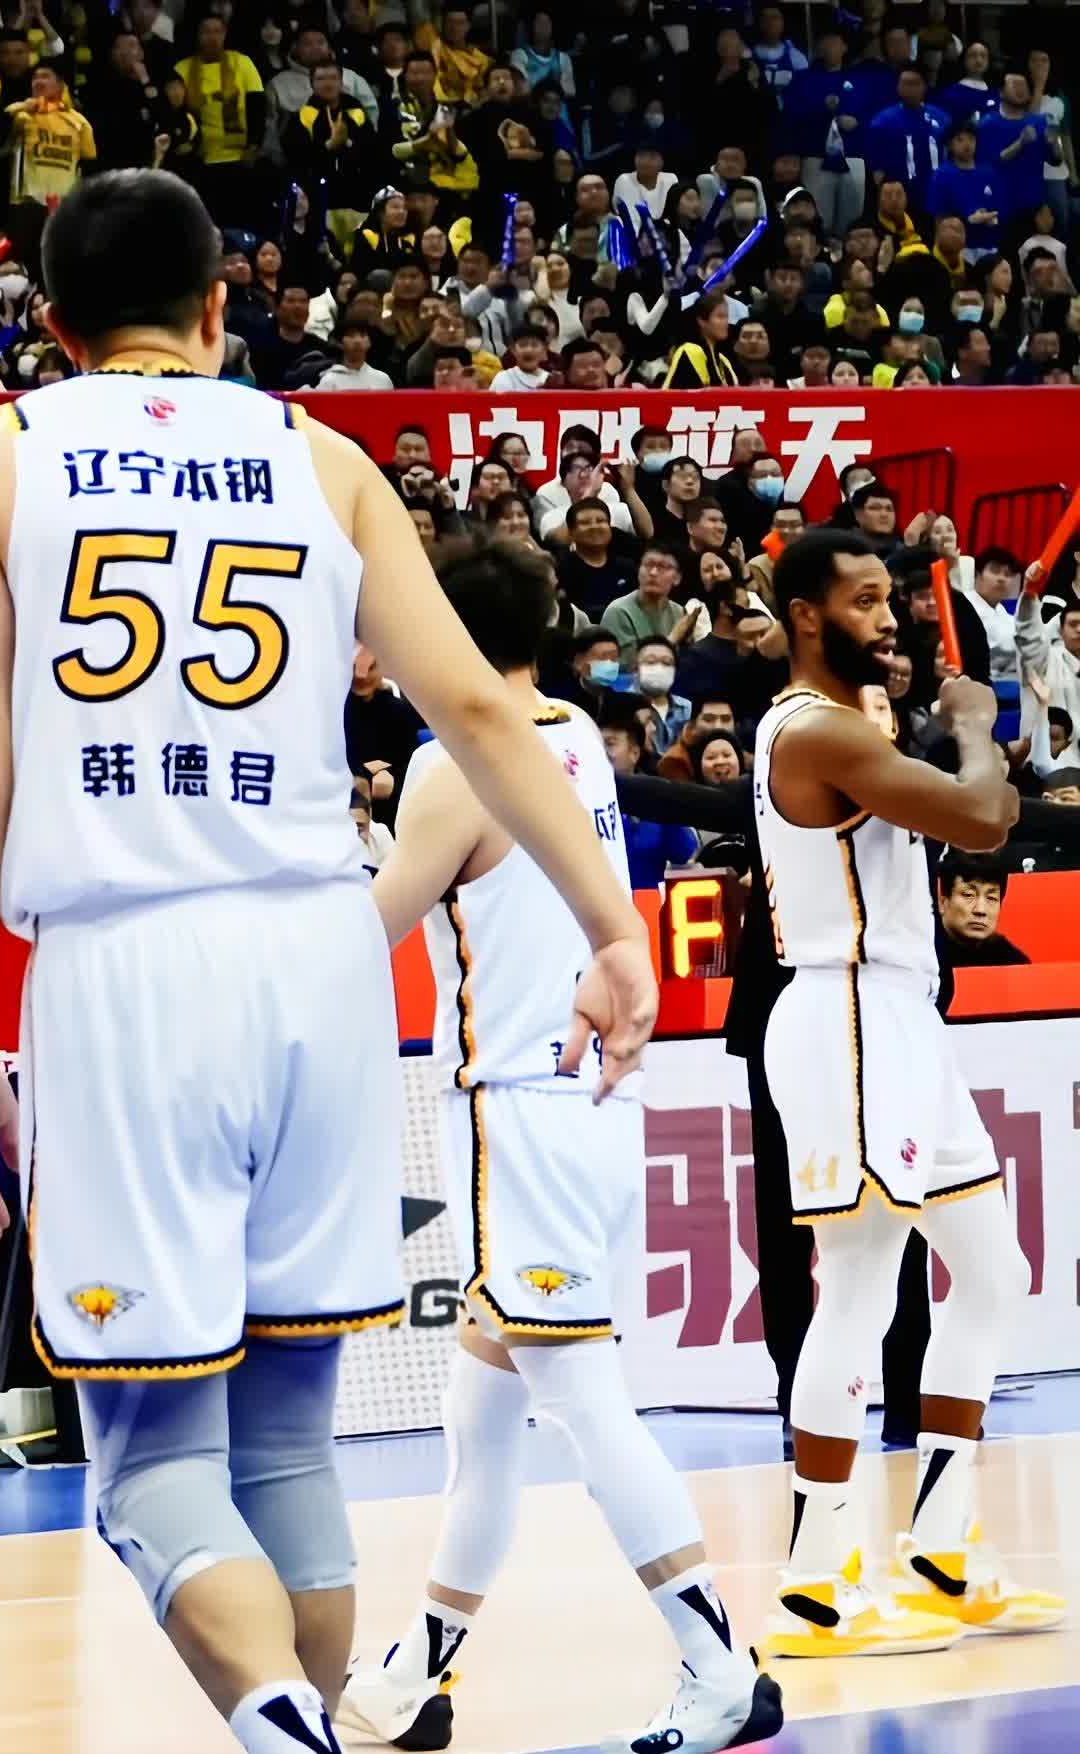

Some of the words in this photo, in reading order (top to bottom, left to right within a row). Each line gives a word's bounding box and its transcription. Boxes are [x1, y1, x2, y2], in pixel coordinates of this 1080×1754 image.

[63, 449, 274, 504] 辽宁本钢
[52, 528, 309, 710] 55
[81, 742, 275, 806] 韩德君
[671, 879, 722, 979] F
